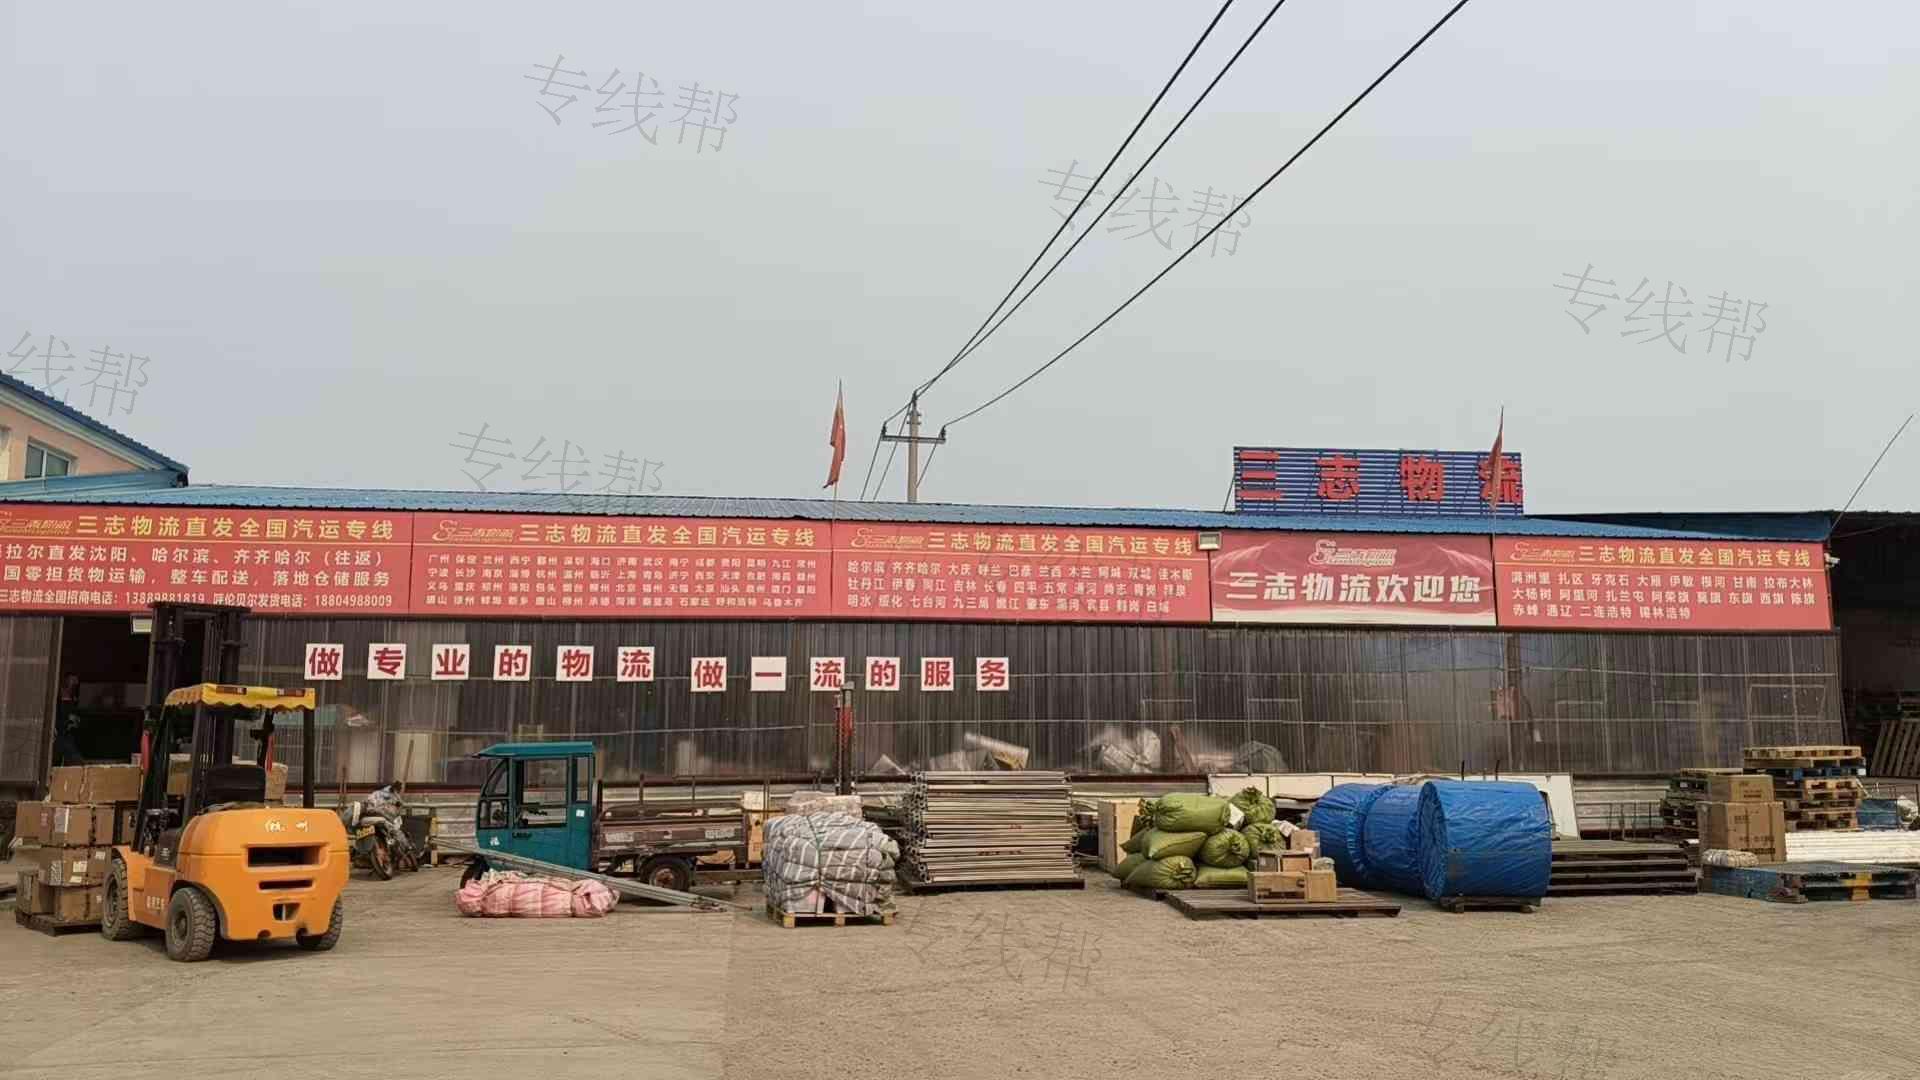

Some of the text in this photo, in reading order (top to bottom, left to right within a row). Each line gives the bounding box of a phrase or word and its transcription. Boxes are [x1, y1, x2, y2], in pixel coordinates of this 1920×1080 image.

[1238, 451, 1523, 504] 三志物流
[77, 515, 393, 540] 三志物流直发全国汽运专线
[519, 524, 814, 546] 三志物流直发全国汽运专线
[928, 532, 1192, 556] 三志物流直发全国汽运专线
[1579, 545, 1811, 567] 三志物流直发全国汽运专线
[948, 563, 971, 576] 大庆
[1227, 571, 1481, 603] 三志物流欢迎您
[308, 647, 1006, 688] 做专业的物流 做一流的服务
